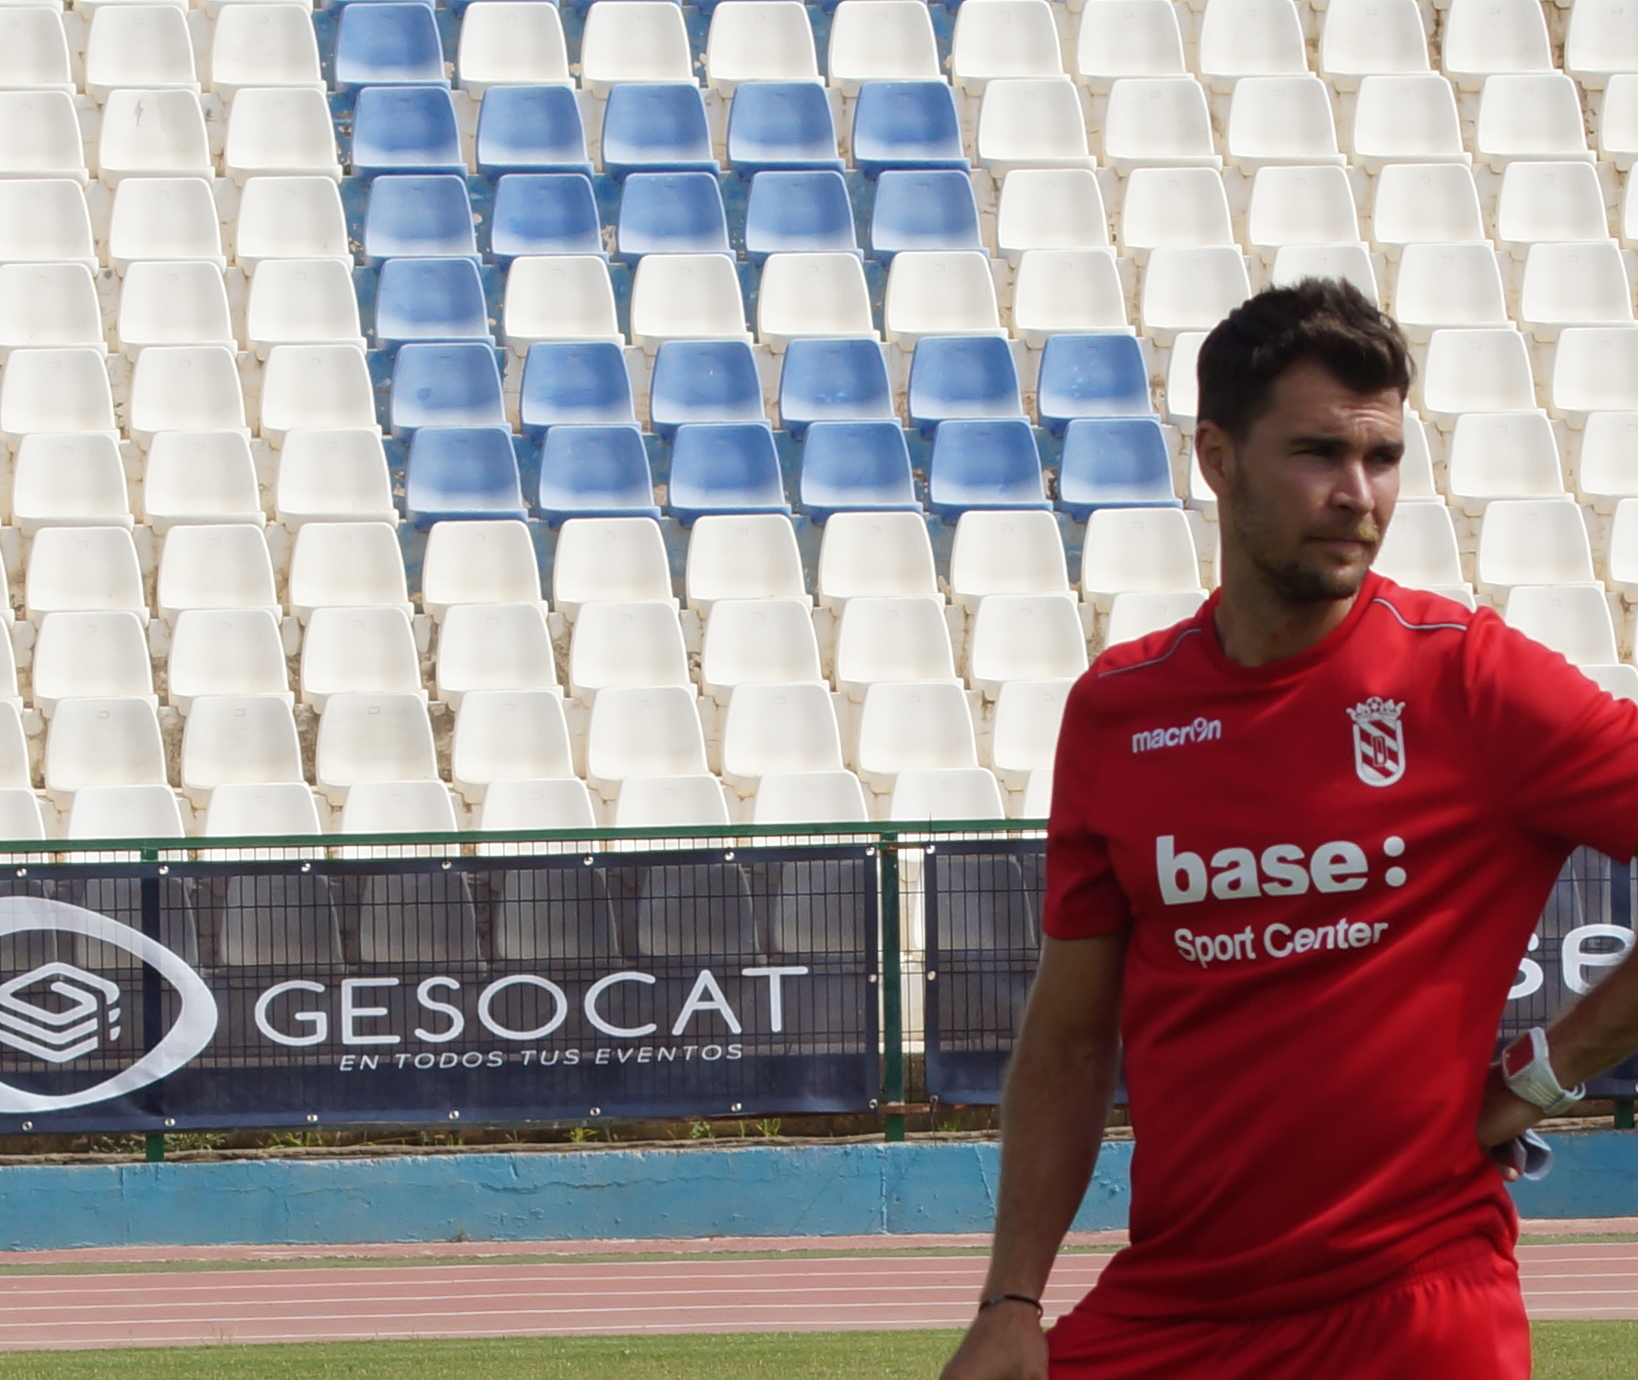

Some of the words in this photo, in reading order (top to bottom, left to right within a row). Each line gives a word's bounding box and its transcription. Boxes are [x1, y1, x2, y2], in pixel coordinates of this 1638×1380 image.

[1174, 925, 1256, 968] Sport
[1263, 917, 1389, 959] Center
[254, 966, 809, 1047] GESOCAT
[339, 1054, 380, 1072] EN
[394, 1050, 504, 1070] TODOS
[521, 1047, 581, 1066] TUS
[595, 1042, 743, 1065] EVENTOS
